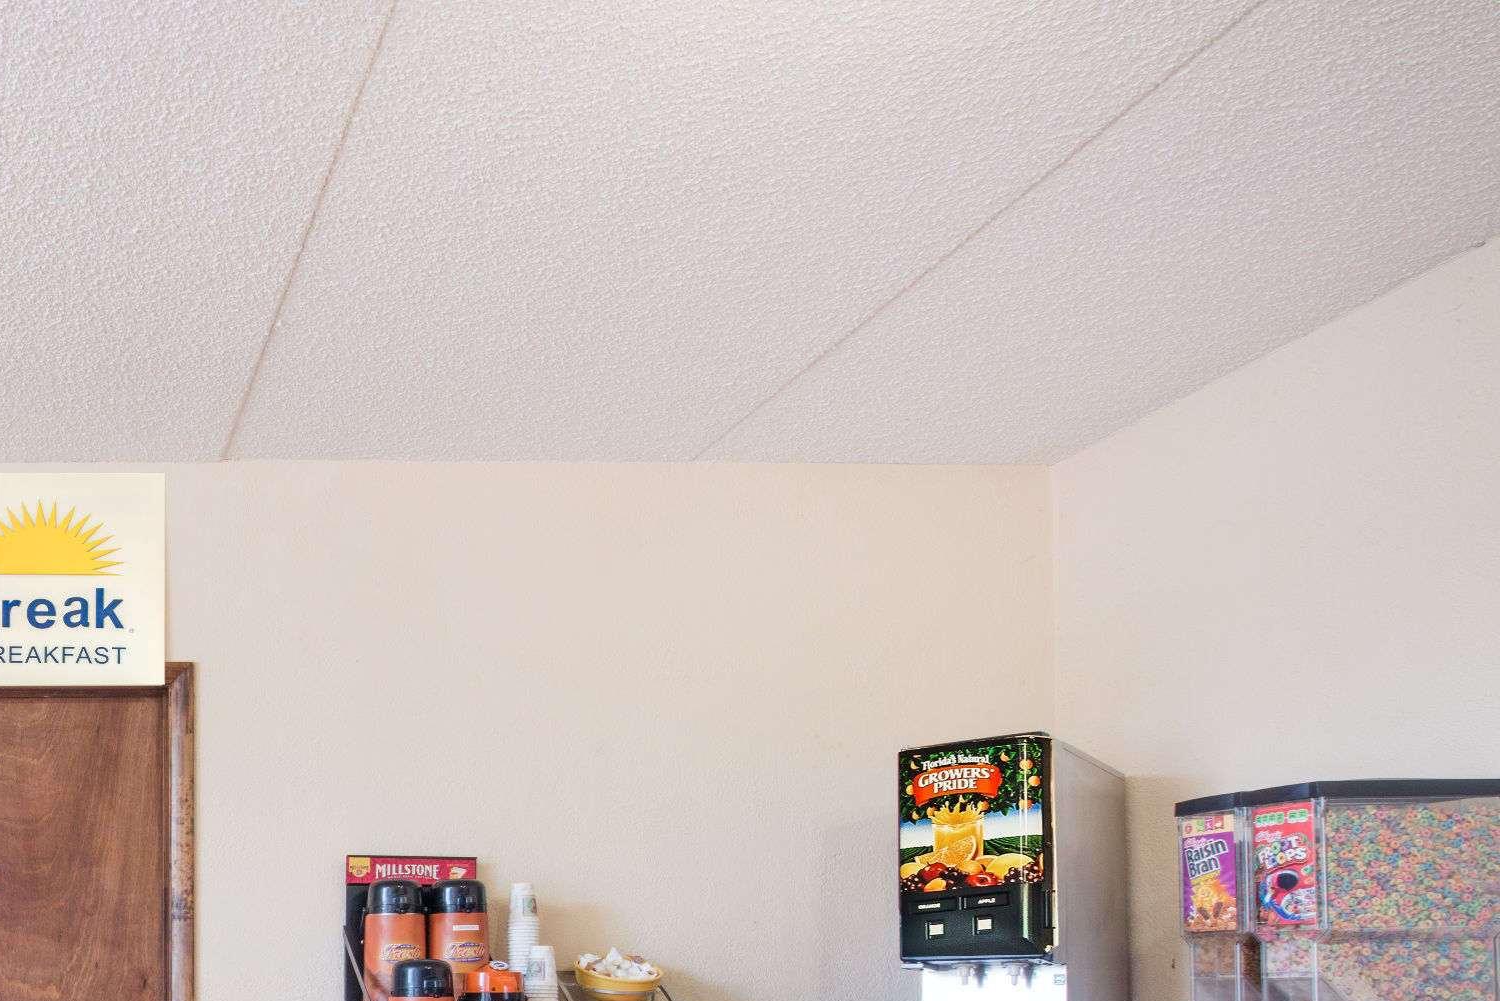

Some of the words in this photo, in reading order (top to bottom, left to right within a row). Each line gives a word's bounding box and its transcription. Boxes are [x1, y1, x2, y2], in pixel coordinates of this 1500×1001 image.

[933, 778, 978, 794] PRIDE
[1186, 840, 1228, 863] Raisin
[375, 863, 440, 880] MILLSTONE
[1188, 857, 1220, 878] Bran
